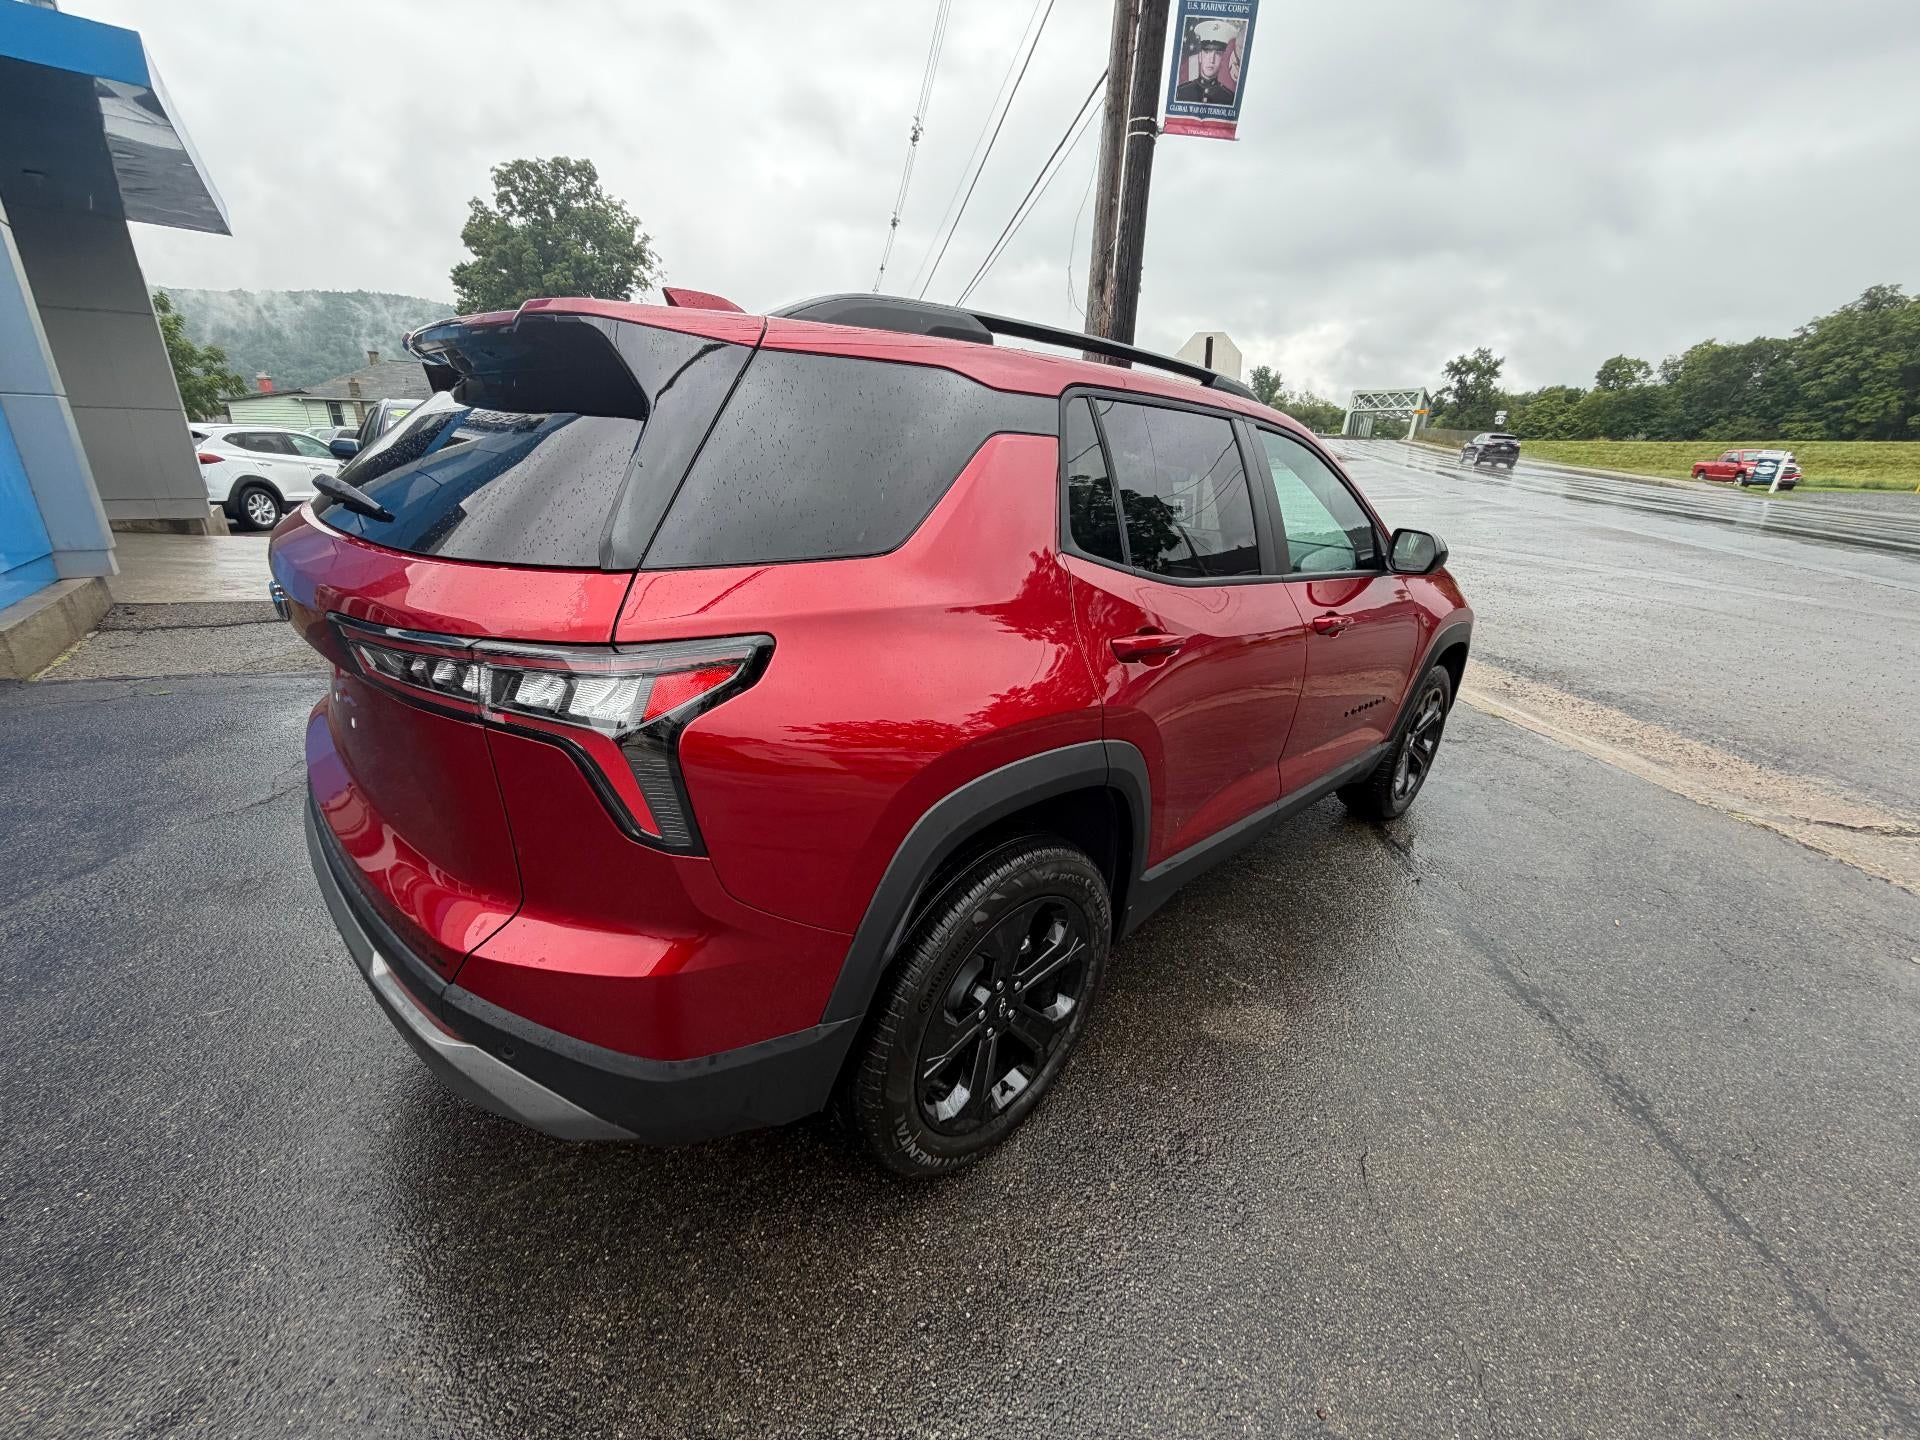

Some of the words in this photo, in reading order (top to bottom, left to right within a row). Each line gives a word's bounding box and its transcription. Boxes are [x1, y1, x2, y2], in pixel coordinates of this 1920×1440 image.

[1187, 2, 1199, 10] U.S.
[1200, 2, 1227, 12] MARINE
[1228, 4, 1250, 14] CORPS
[1169, 104, 1188, 113] GLOBAL
[1189, 106, 1200, 114] WAR
[1200, 106, 1207, 114] ON
